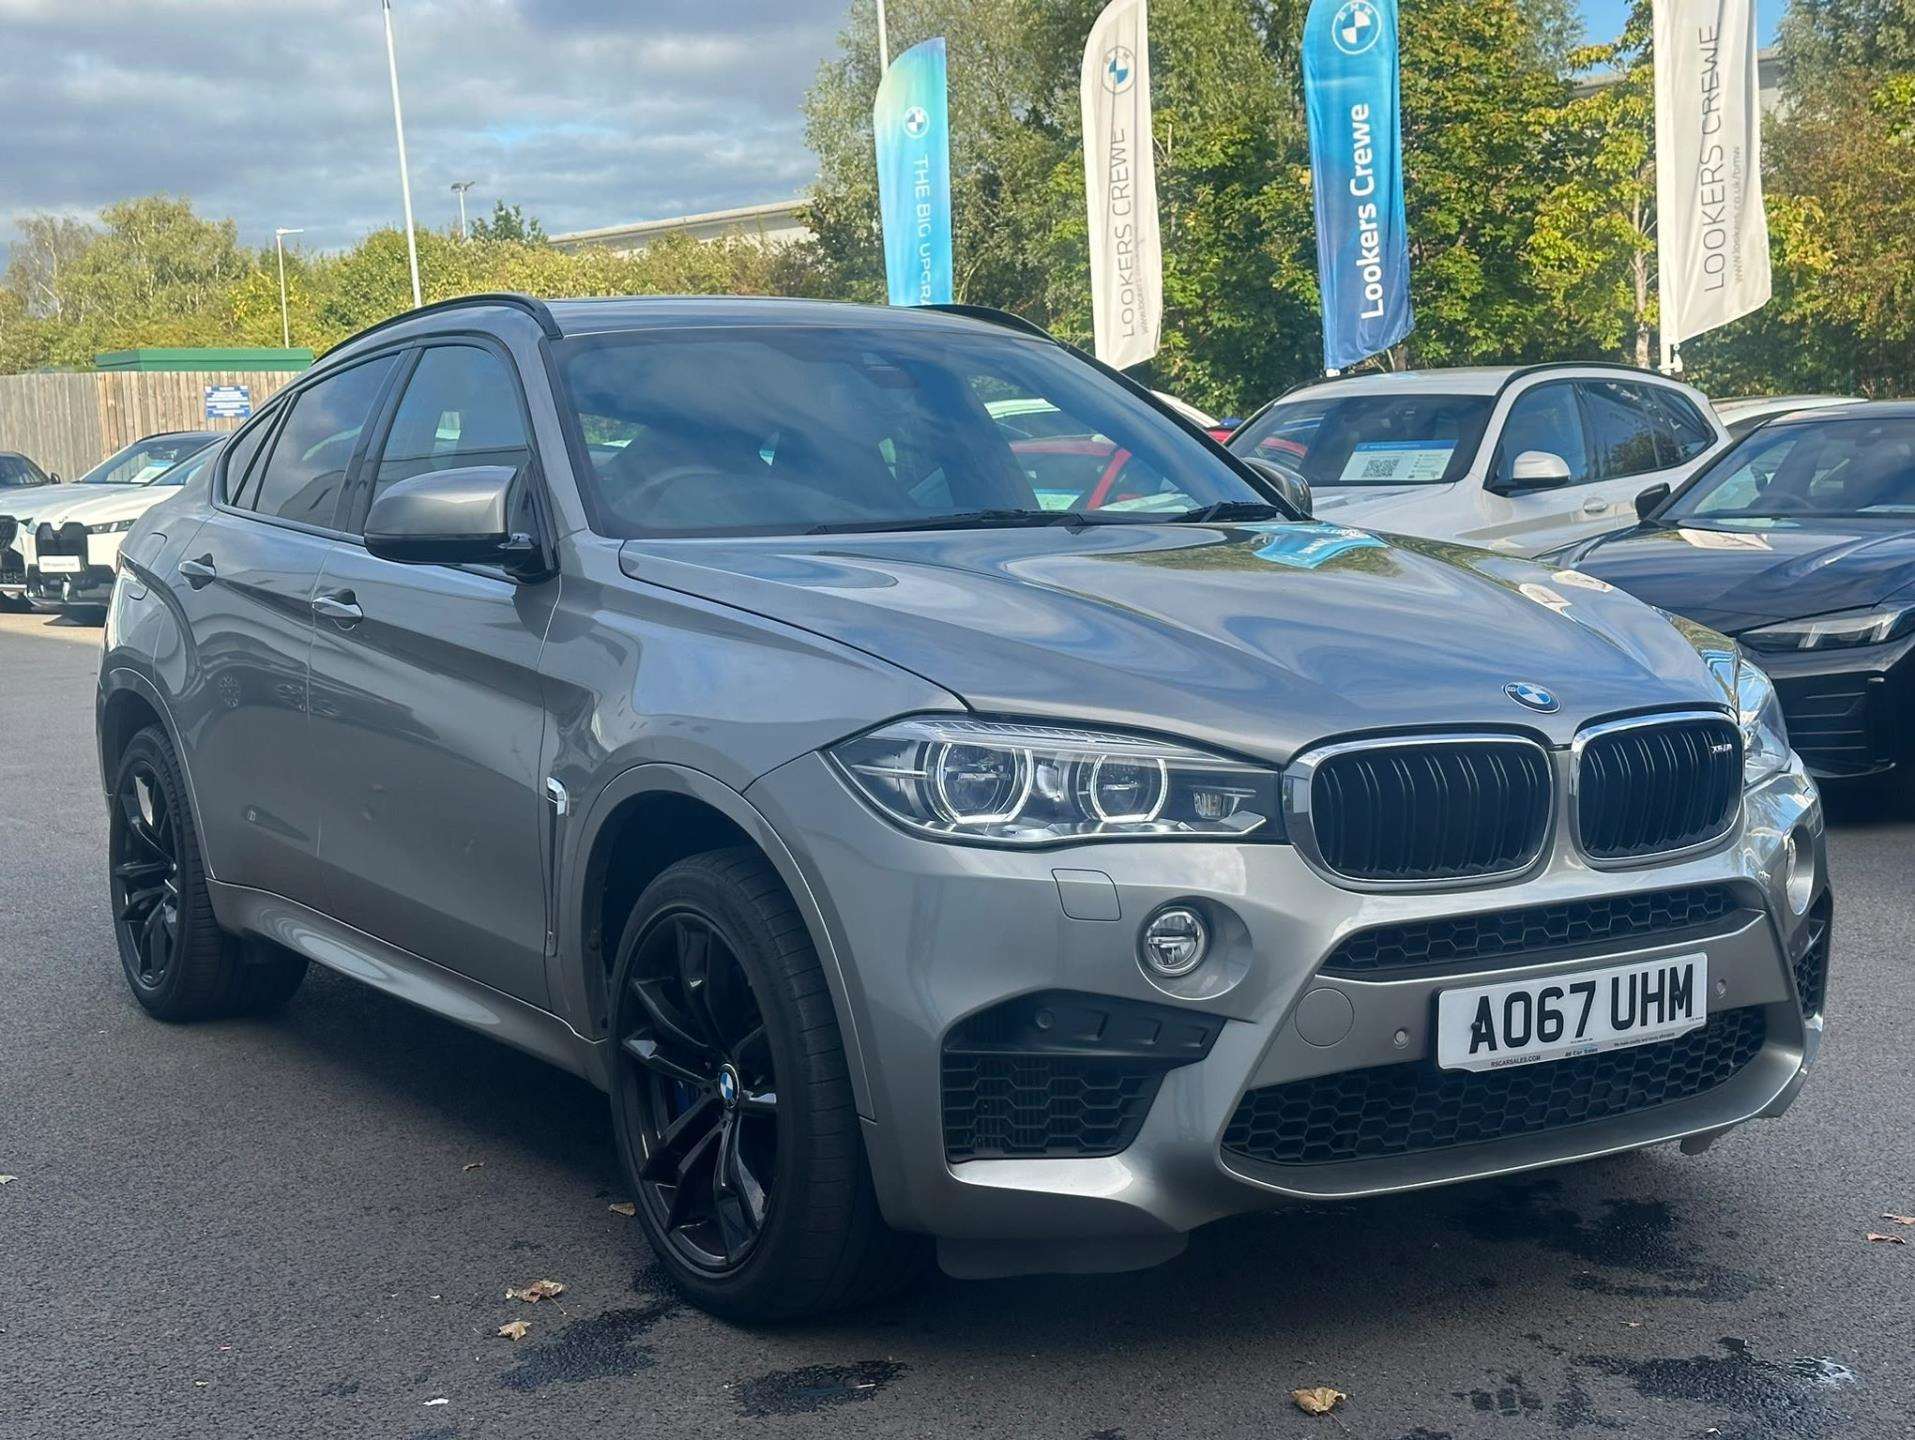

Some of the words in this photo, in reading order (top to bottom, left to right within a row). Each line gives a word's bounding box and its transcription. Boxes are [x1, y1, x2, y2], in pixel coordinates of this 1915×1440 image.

[1699, 26, 1722, 136] CREWE
[912, 154, 930, 197] THE
[1109, 128, 1133, 217] CREWE
[1349, 102, 1375, 197] Crewe
[916, 202, 932, 239] BIG
[1356, 204, 1385, 320] Lookers
[1700, 145, 1726, 292] LOOKERS
[1114, 224, 1135, 339] LOOKERS
[1610, 963, 1694, 1031] UHM
